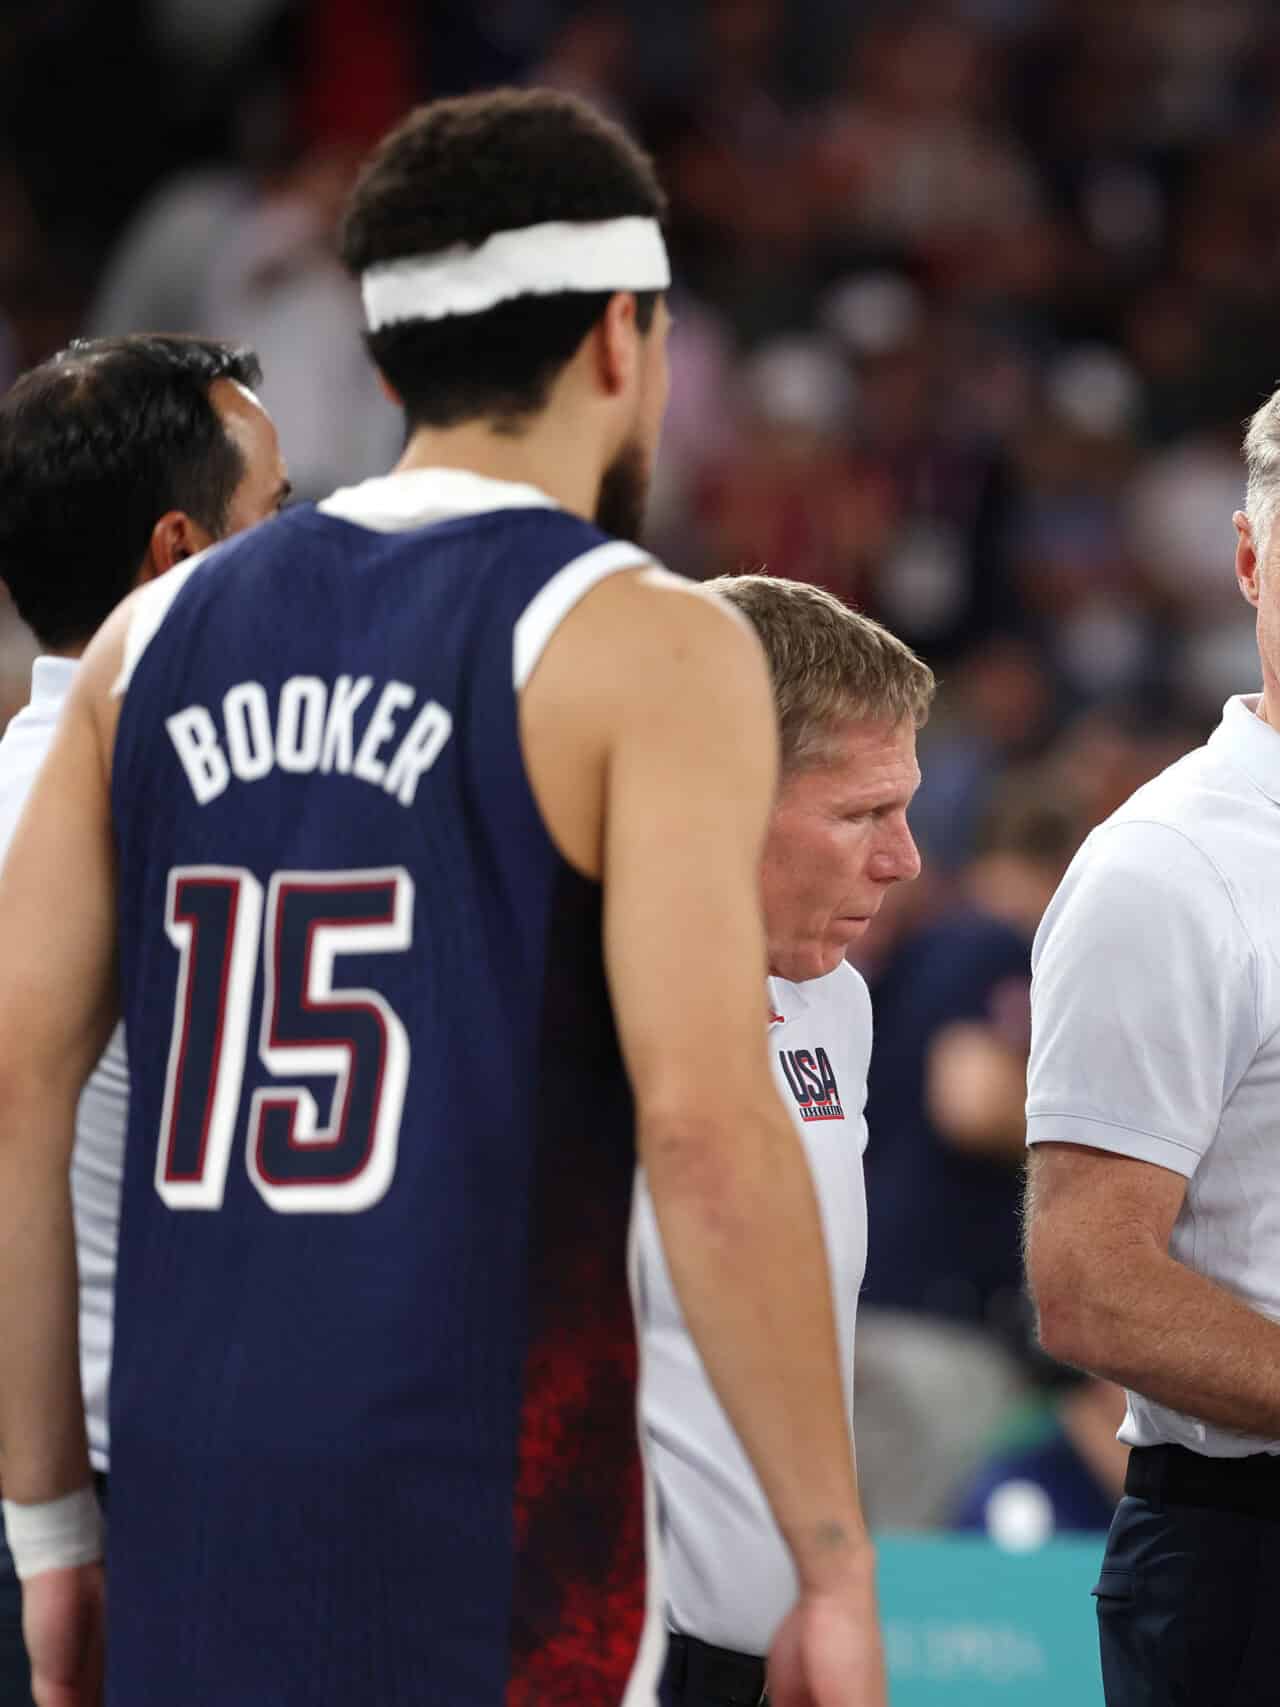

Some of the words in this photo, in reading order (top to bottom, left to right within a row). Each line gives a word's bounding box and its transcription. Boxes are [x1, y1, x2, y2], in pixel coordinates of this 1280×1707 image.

[166, 675, 453, 806] BOOKER
[154, 866, 415, 1213] 15
[779, 1047, 841, 1107] USA
